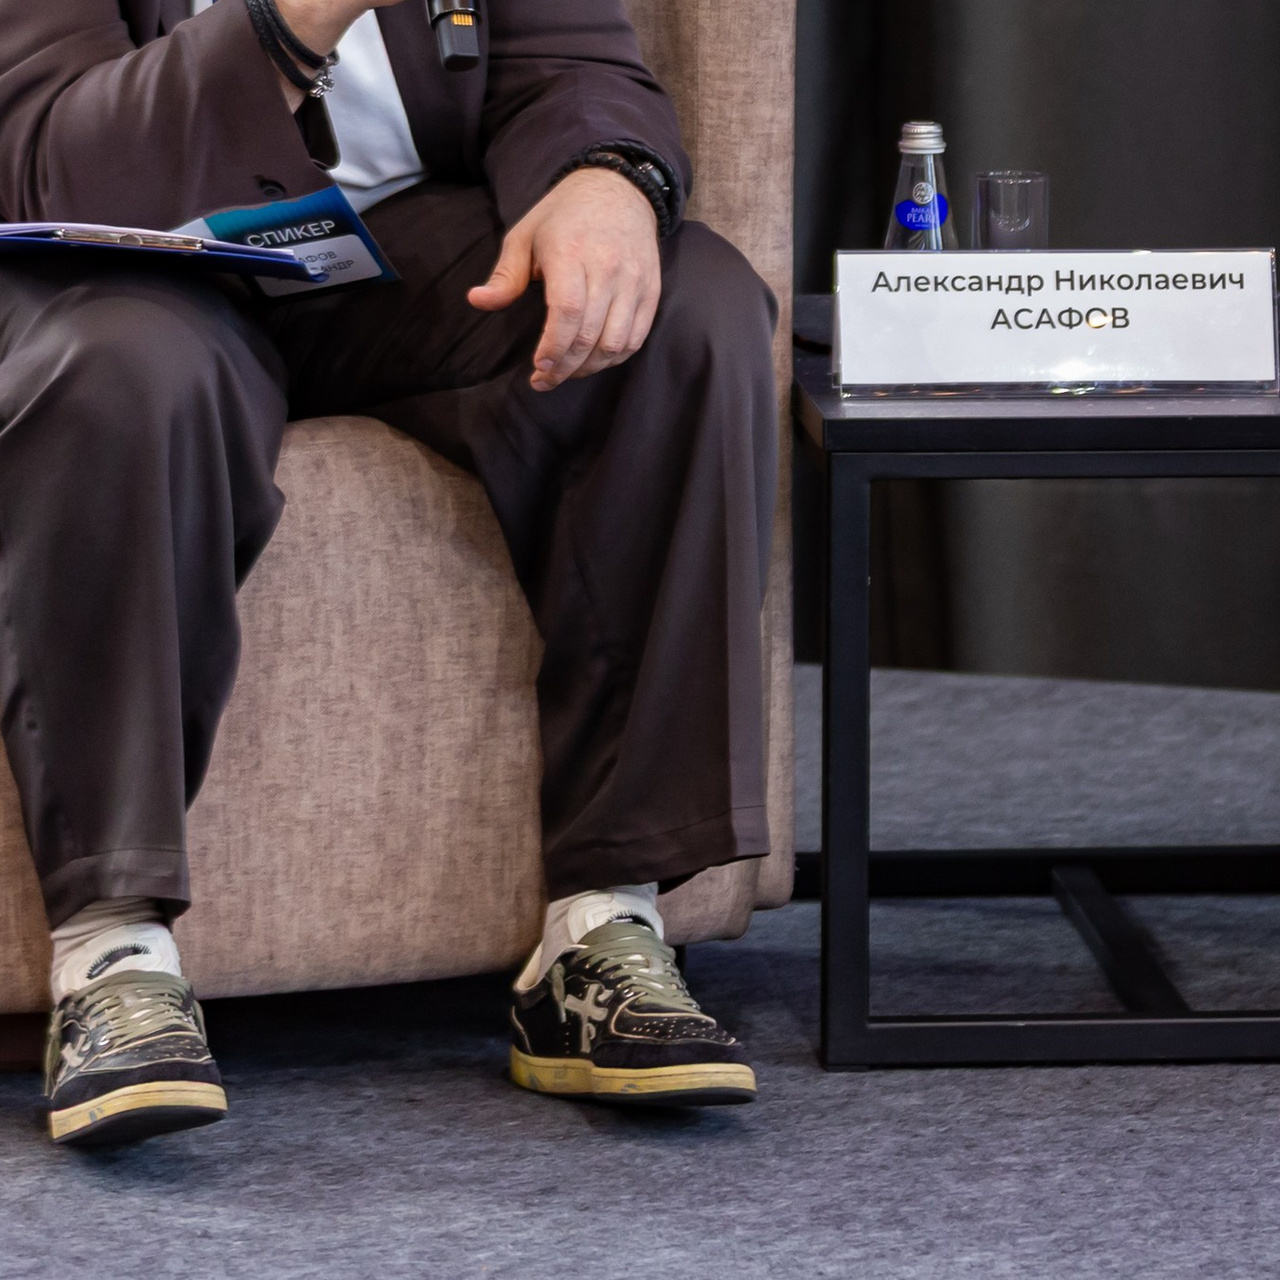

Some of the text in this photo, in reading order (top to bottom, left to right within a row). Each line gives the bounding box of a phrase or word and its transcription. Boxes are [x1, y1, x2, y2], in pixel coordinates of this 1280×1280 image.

[247, 220, 336, 248] СПИКЕР
[871, 269, 1245, 297] Александр Николаевич
[990, 307, 1130, 330] АСАФОВ
